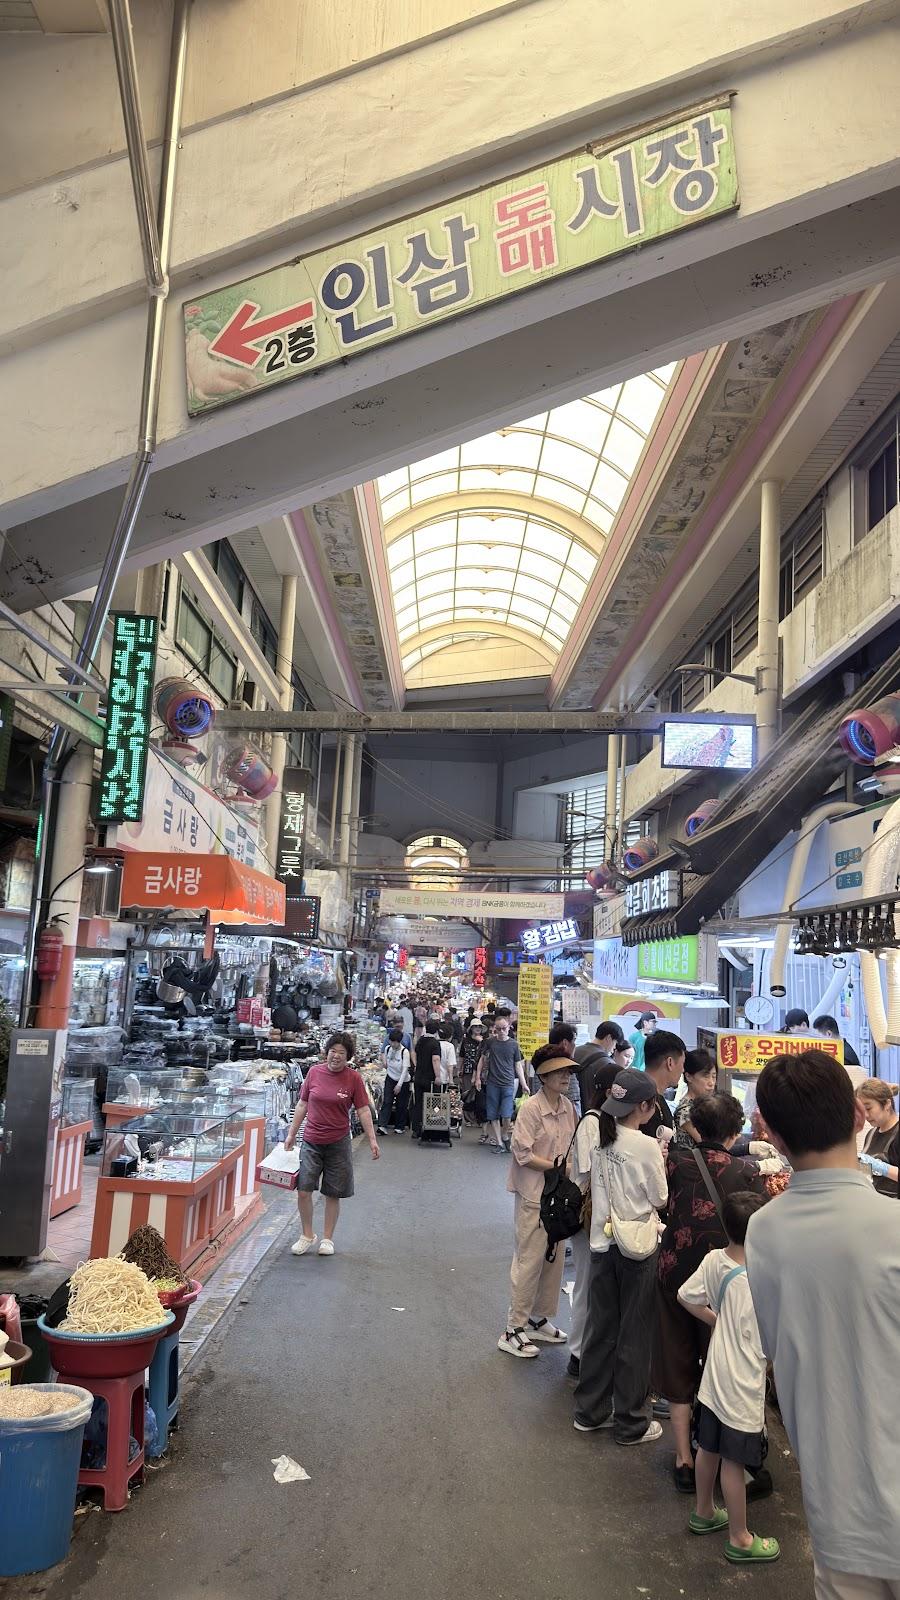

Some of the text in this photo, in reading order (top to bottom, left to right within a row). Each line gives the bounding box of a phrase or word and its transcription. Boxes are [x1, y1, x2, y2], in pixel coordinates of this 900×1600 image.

[322, 115, 726, 344] 인삼 도매 시장
[265, 324, 317, 373] 2층
[279, 791, 305, 877] 형제그릇
[144, 865, 202, 895] 금사랑
[450, 896, 465, 907] 지역
[466, 897, 481, 908] 경제
[523, 919, 577, 950] 왕김밥
